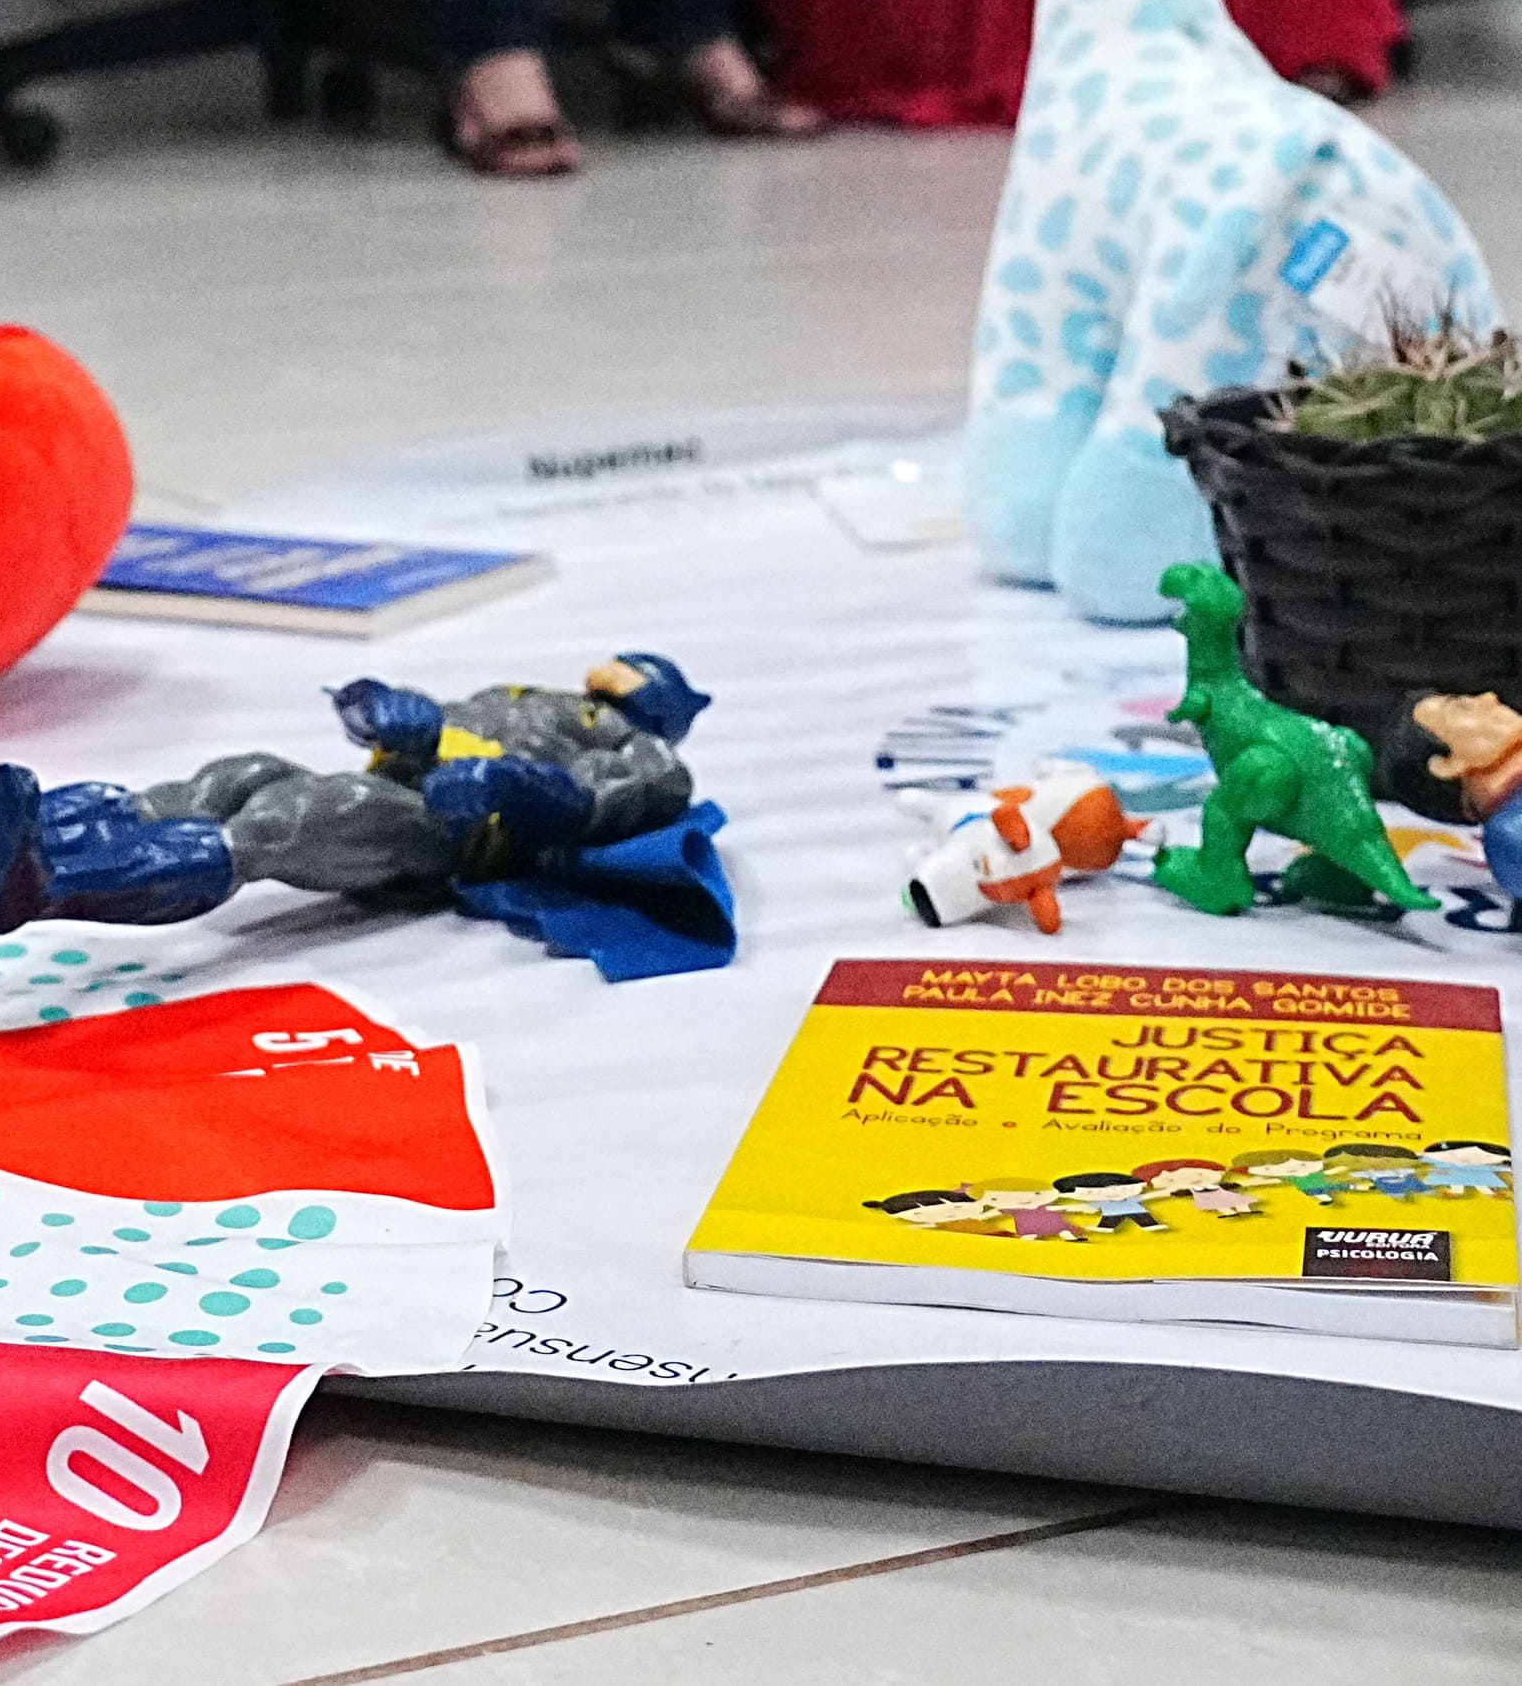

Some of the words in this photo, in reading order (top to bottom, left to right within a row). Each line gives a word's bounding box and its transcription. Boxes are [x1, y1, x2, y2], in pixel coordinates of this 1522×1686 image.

[902, 985, 1014, 1004] PAULA
[1033, 988, 1114, 1008] INEZ
[1129, 992, 1253, 1012] CUNHA
[1271, 997, 1412, 1020] GOMIDE
[921, 969, 1037, 986] MAYTA
[1057, 973, 1147, 992] LOBO
[1162, 976, 1235, 995] DOS
[1253, 980, 1401, 1002] SANTOS
[1112, 1024, 1427, 1060] JUSTIÇA
[862, 1045, 1427, 1090] RESTAURATIVA
[846, 1073, 977, 1110] NA
[1046, 1080, 1425, 1123] ESCOLA
[840, 1108, 979, 1127] Aplicação
[1002, 1120, 1018, 1129] e
[1041, 1118, 1183, 1135] Avaliação
[1265, 1121, 1423, 1143] Programa
[1316, 1249, 1440, 1261] PSICOLOGIA
[46, 1378, 212, 1532] 10
